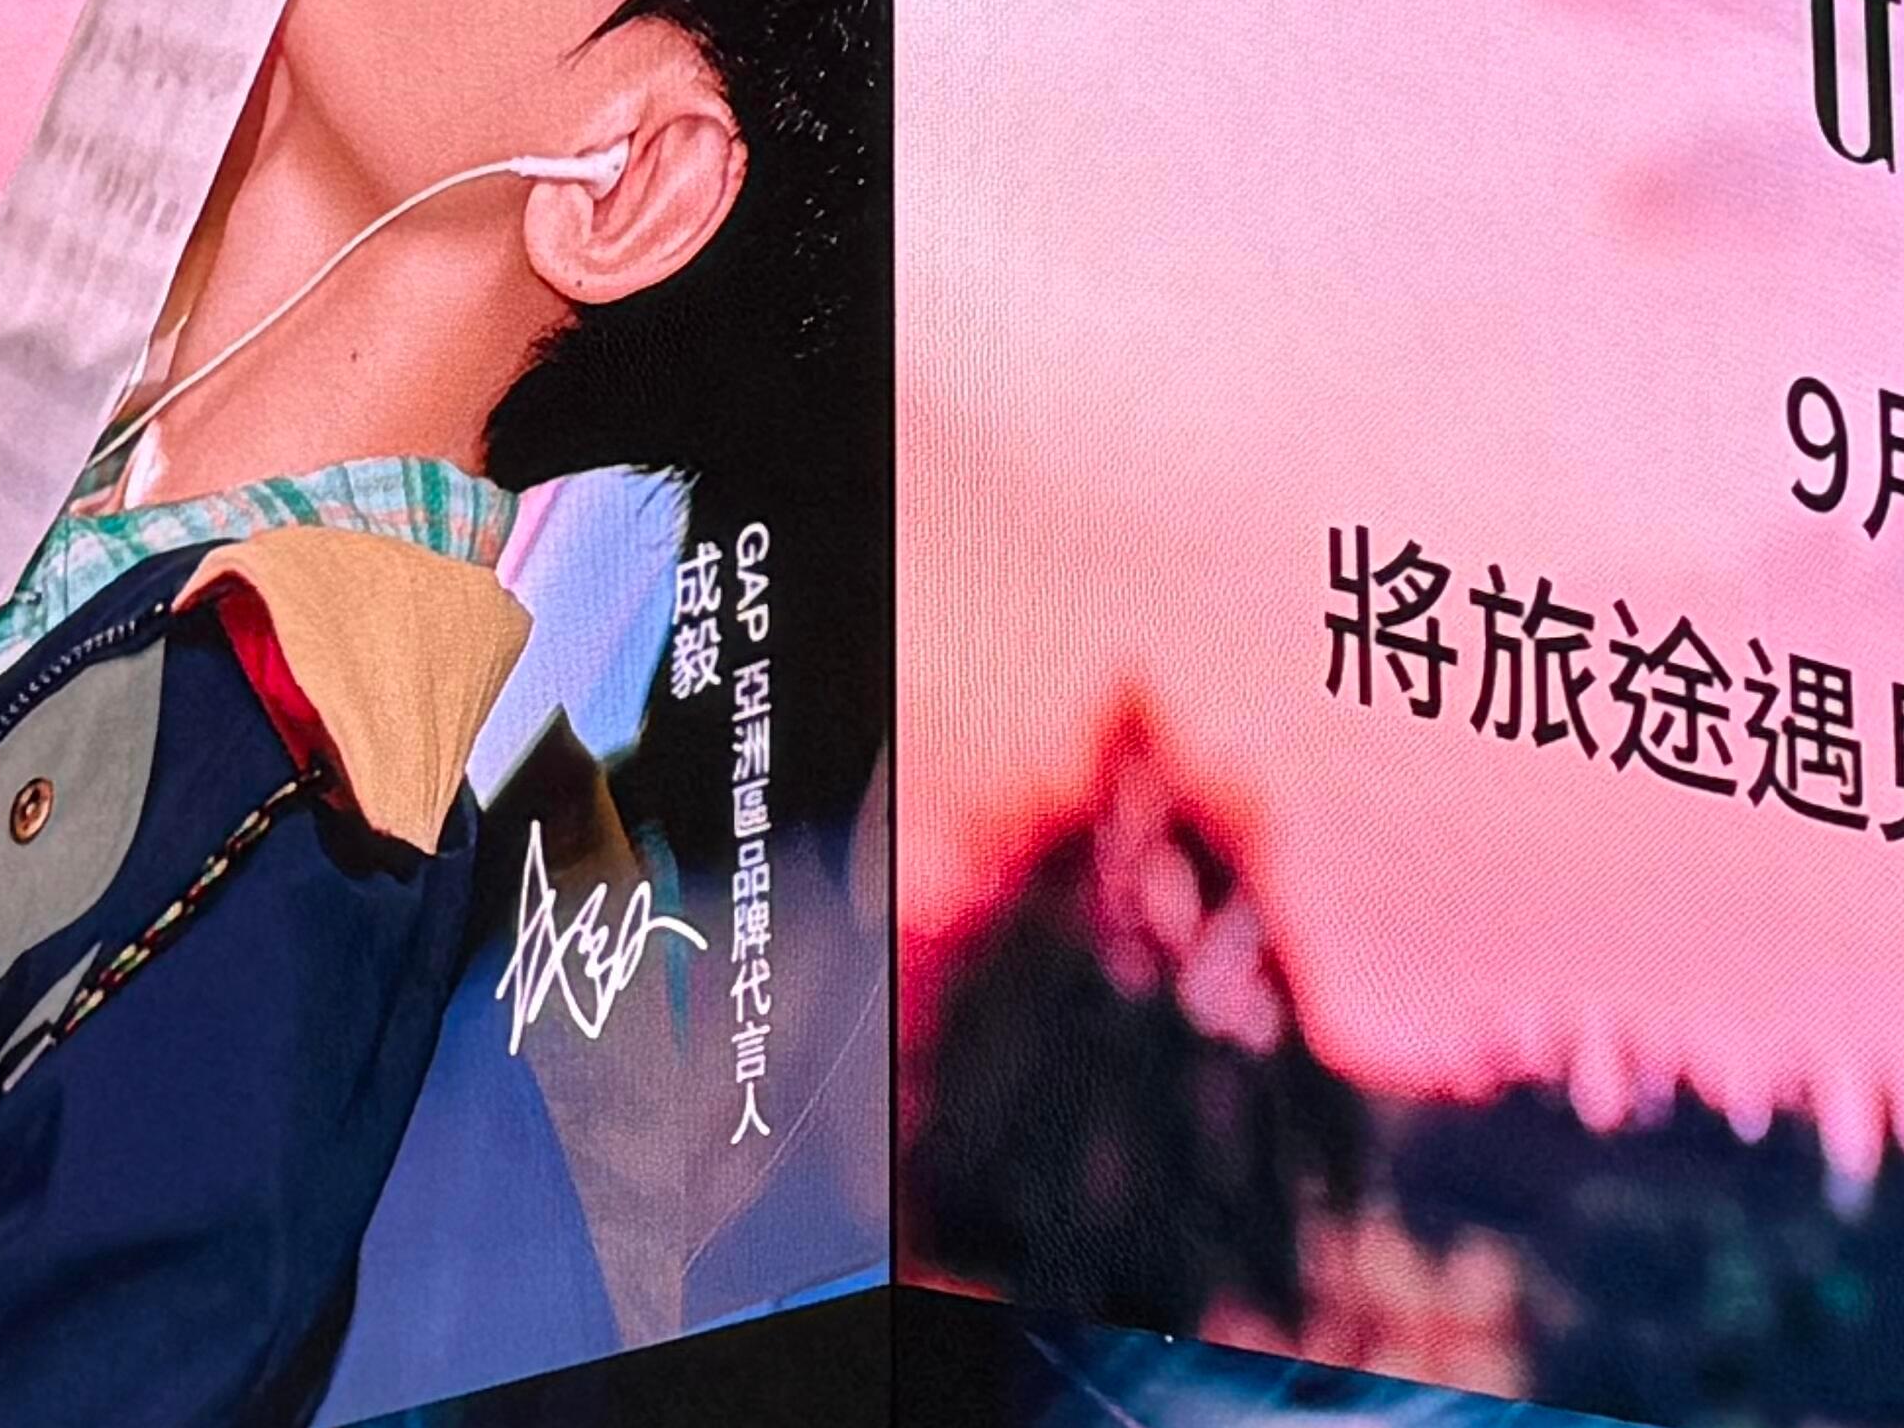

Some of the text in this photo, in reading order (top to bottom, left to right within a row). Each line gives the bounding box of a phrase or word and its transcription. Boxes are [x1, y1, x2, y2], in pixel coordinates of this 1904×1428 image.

[670, 541, 723, 700] 成毅
[730, 522, 771, 1145] GAP 亞洲區品牌代言人
